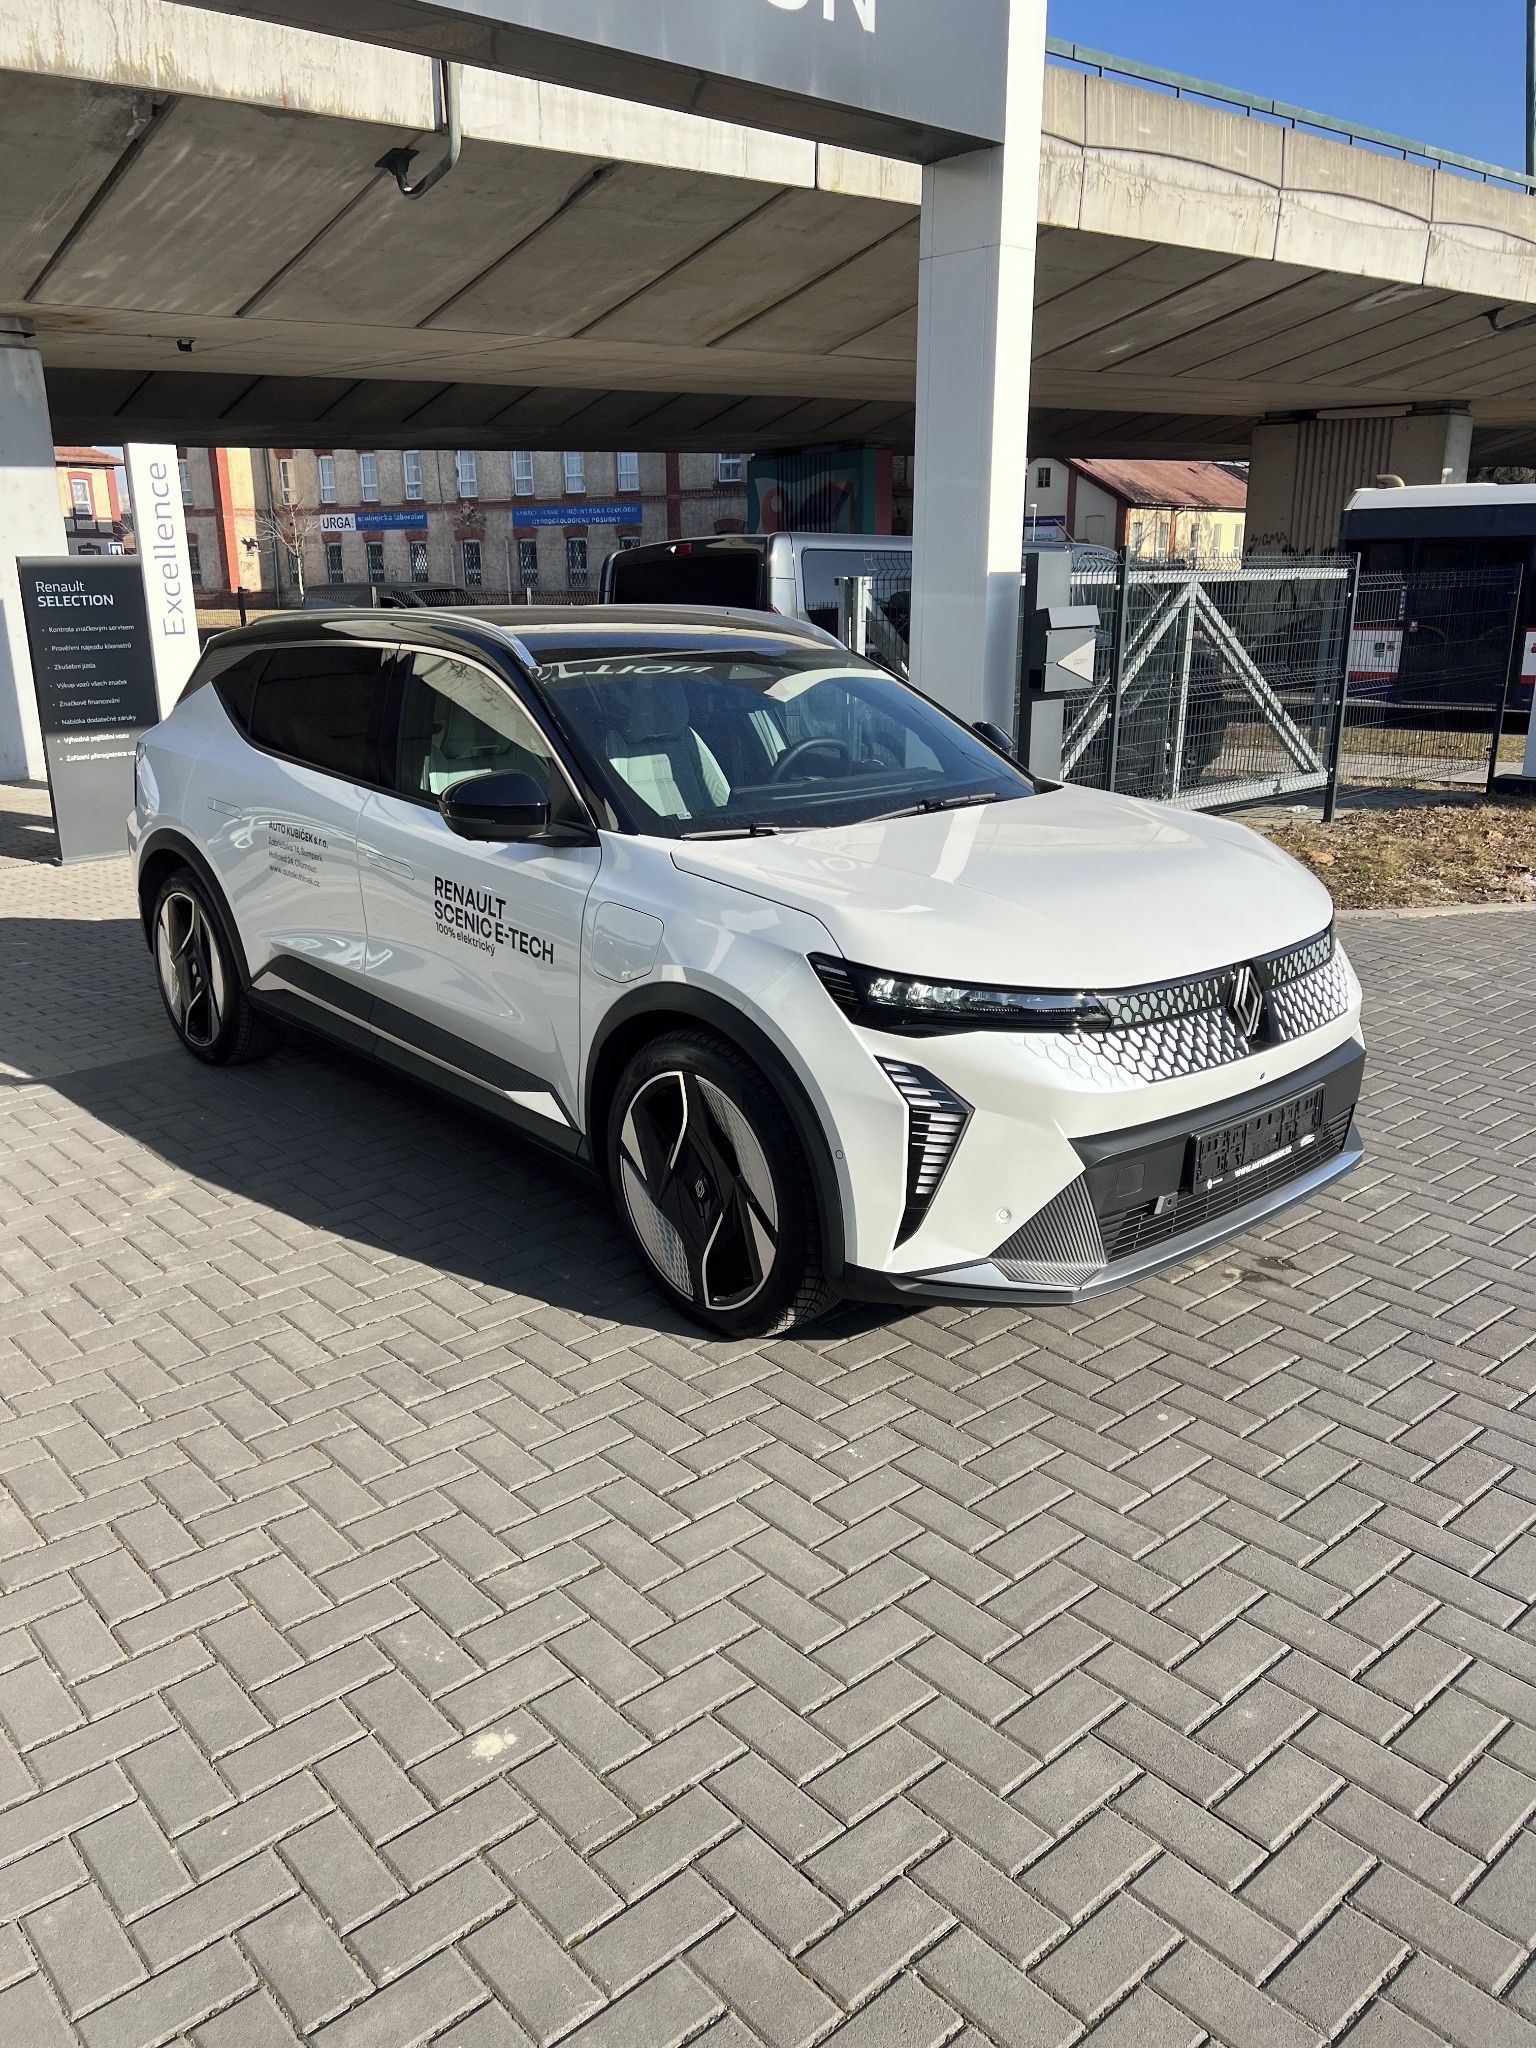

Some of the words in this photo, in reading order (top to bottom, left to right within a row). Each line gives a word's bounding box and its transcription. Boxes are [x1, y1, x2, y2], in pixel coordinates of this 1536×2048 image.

[322, 516, 351, 529] URGA
[150, 462, 186, 636] Excellence
[35, 580, 85, 593] Renault
[37, 594, 114, 607] SELECTION
[75, 625, 108, 633] značkovým
[54, 663, 82, 671] Zkušební
[56, 682, 76, 690] Výkup
[268, 821, 286, 834] AUTO
[286, 825, 313, 844] KUBÍČEK
[294, 859, 317, 874] Olomouc
[434, 875, 506, 920] RENAULT
[434, 899, 492, 938] SCENIC
[495, 921, 554, 965] E-TECH
[435, 921, 456, 939] 100%
[456, 930, 496, 957] elektrický
